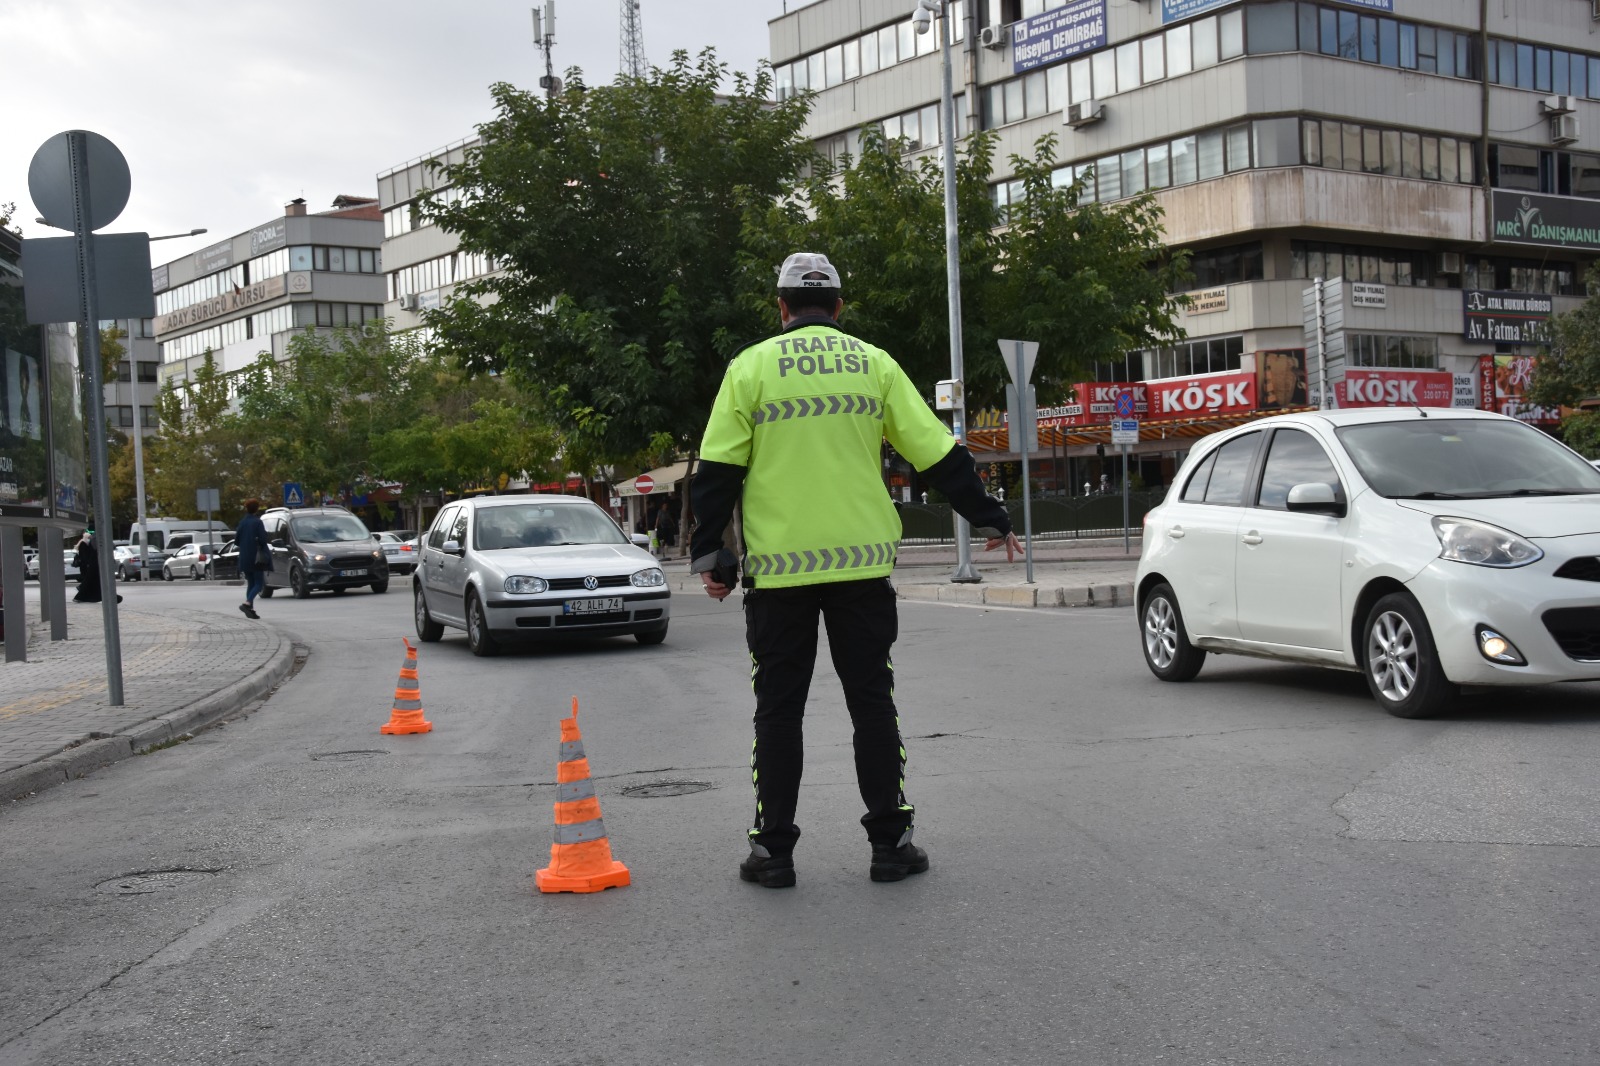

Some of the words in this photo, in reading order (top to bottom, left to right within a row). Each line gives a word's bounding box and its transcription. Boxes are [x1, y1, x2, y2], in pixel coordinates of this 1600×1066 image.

[1056, 6, 1102, 28] MÜŞAVİR
[1015, 38, 1051, 63] Hüseyin
[1053, 16, 1103, 51] DEMİRBAĞ
[1041, 51, 1063, 62] 320
[258, 226, 277, 243] DORA
[1496, 220, 1521, 237] MRC
[167, 310, 189, 329] ADAY
[191, 296, 228, 321] SÜRÜCÜ
[232, 285, 266, 308] KURSU
[1487, 297, 1503, 310] ATAL
[1503, 298, 1525, 311] HUKUK
[1468, 318, 1485, 339] Av.
[1487, 319, 1520, 341] Fatma
[1454, 375, 1471, 386] DÖNER
[1095, 384, 1147, 402] KÖK
[1162, 381, 1250, 413] KÖŞK
[1346, 374, 1418, 407] KÖŞK
[571, 600, 582, 611] 42
[587, 600, 604, 610] ALH
[608, 598, 619, 609] 74
